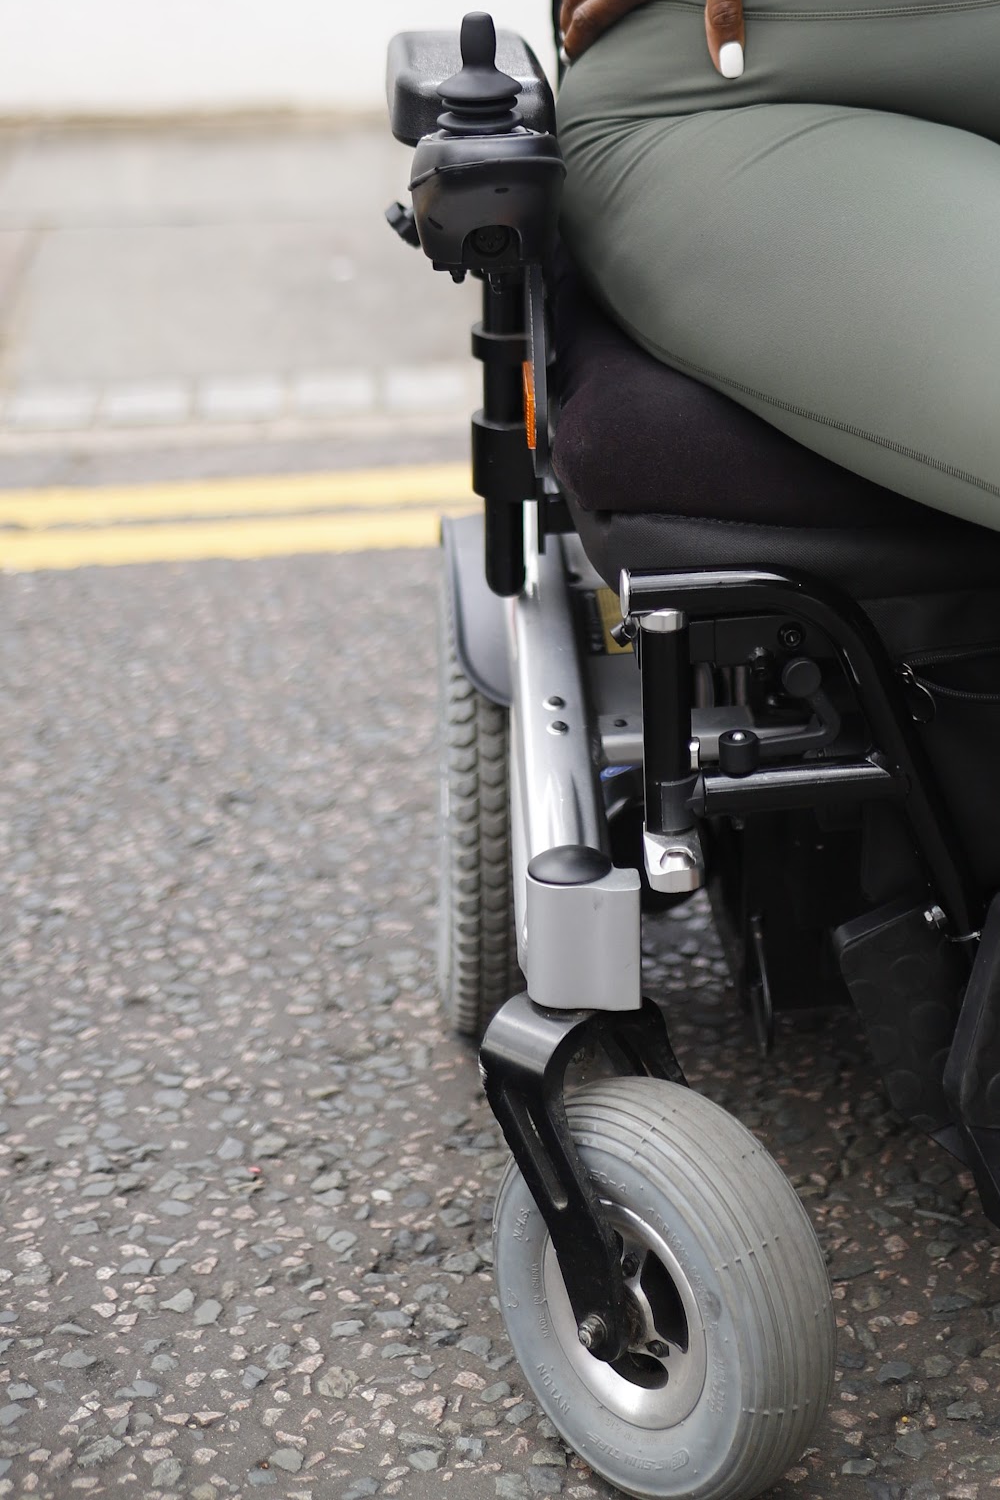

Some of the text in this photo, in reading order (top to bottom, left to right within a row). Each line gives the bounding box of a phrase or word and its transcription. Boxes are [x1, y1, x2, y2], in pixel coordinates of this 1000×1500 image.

[512, 1208, 531, 1242] N.H.S.
[531, 1262, 541, 1290] CHINA
[537, 1312, 551, 1339] MADE
[537, 1363, 571, 1415] NYLON
[587, 1431, 620, 1460] TIRE
[624, 1452, 656, 1471] SHIN
